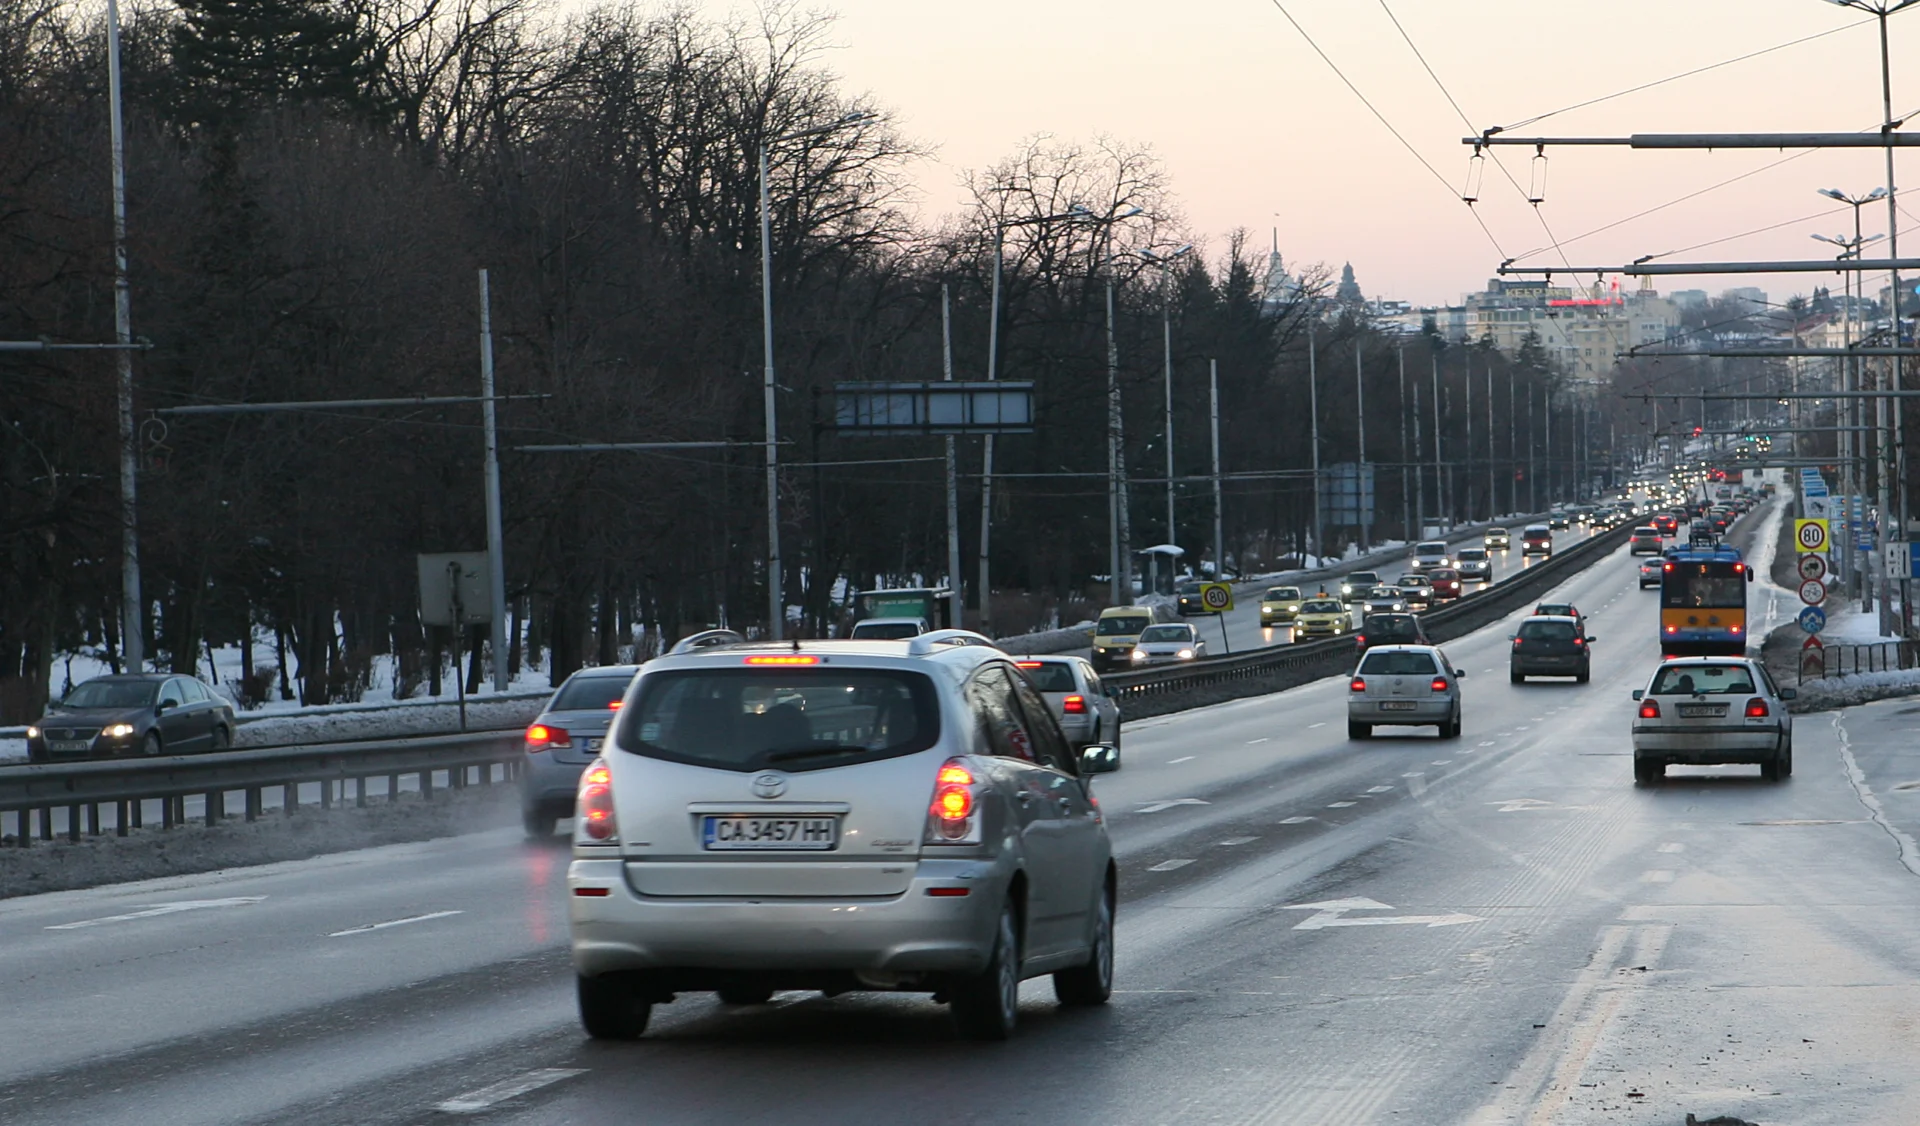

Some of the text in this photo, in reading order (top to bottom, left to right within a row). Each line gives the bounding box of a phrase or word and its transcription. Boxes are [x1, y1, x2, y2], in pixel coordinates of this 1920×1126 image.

[1505, 288, 1542, 298] KEEP
[1803, 528, 1820, 543] 80
[1209, 591, 1225, 603] 80
